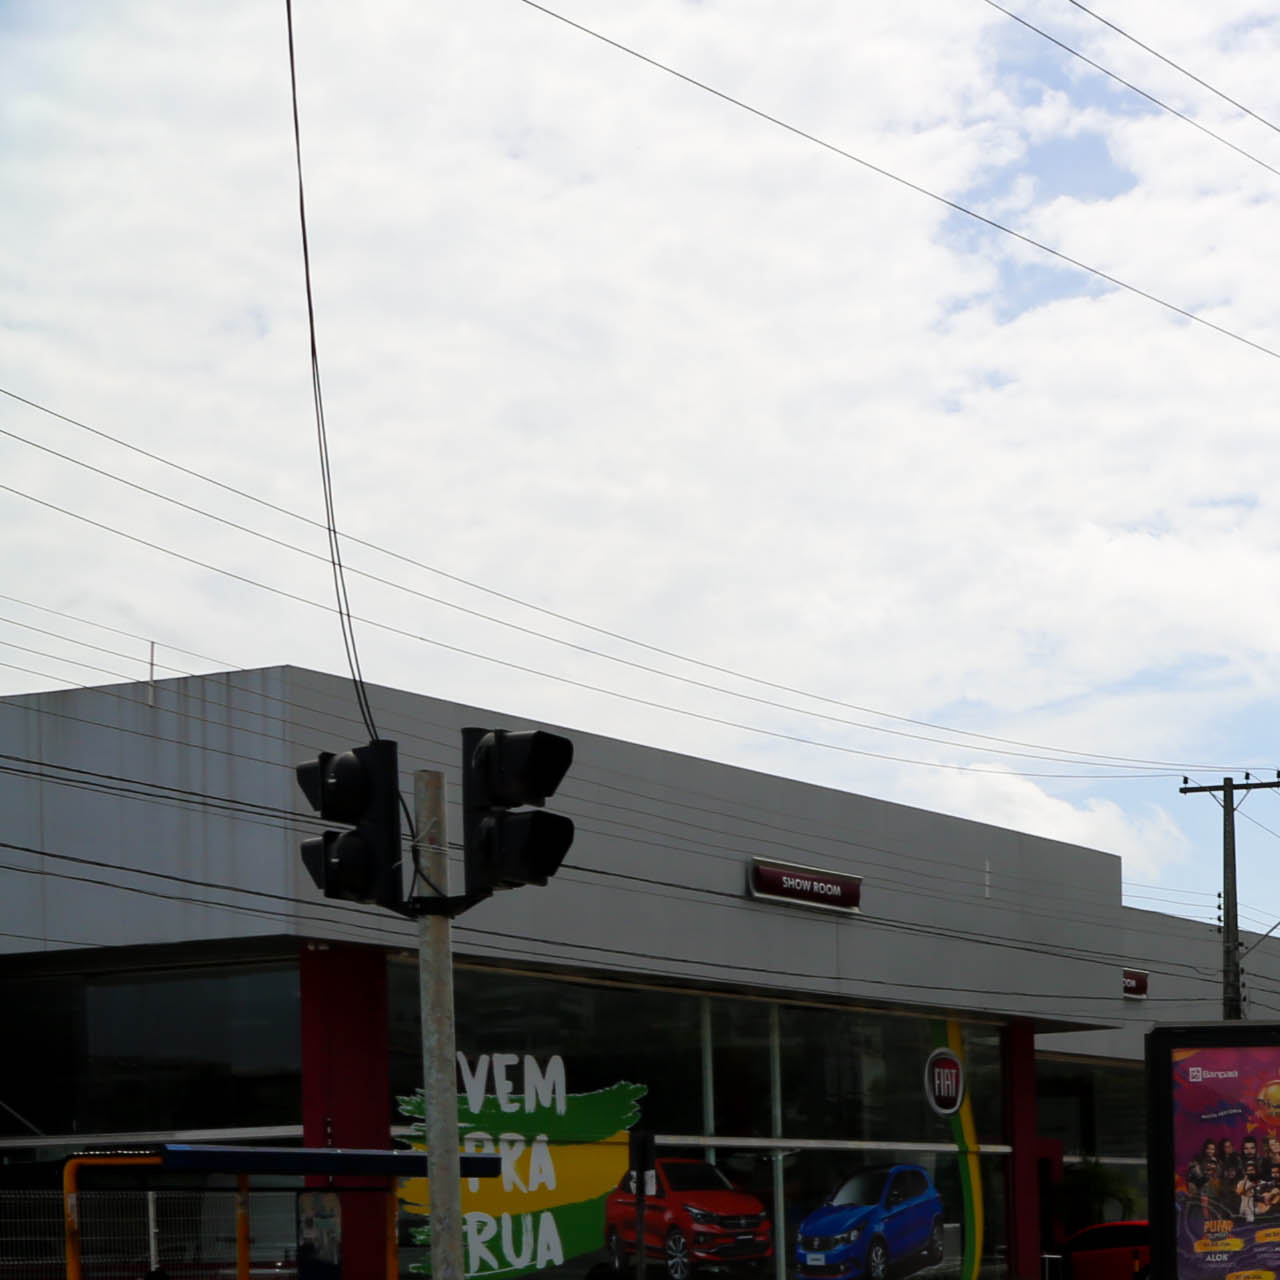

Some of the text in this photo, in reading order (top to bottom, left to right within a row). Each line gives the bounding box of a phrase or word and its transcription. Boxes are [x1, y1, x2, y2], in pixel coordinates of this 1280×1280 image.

[782, 876, 842, 897] SHOW ROOM
[456, 1050, 567, 1116] VEM
[934, 1067, 957, 1097] FIAT
[462, 1211, 565, 1274] RUA
